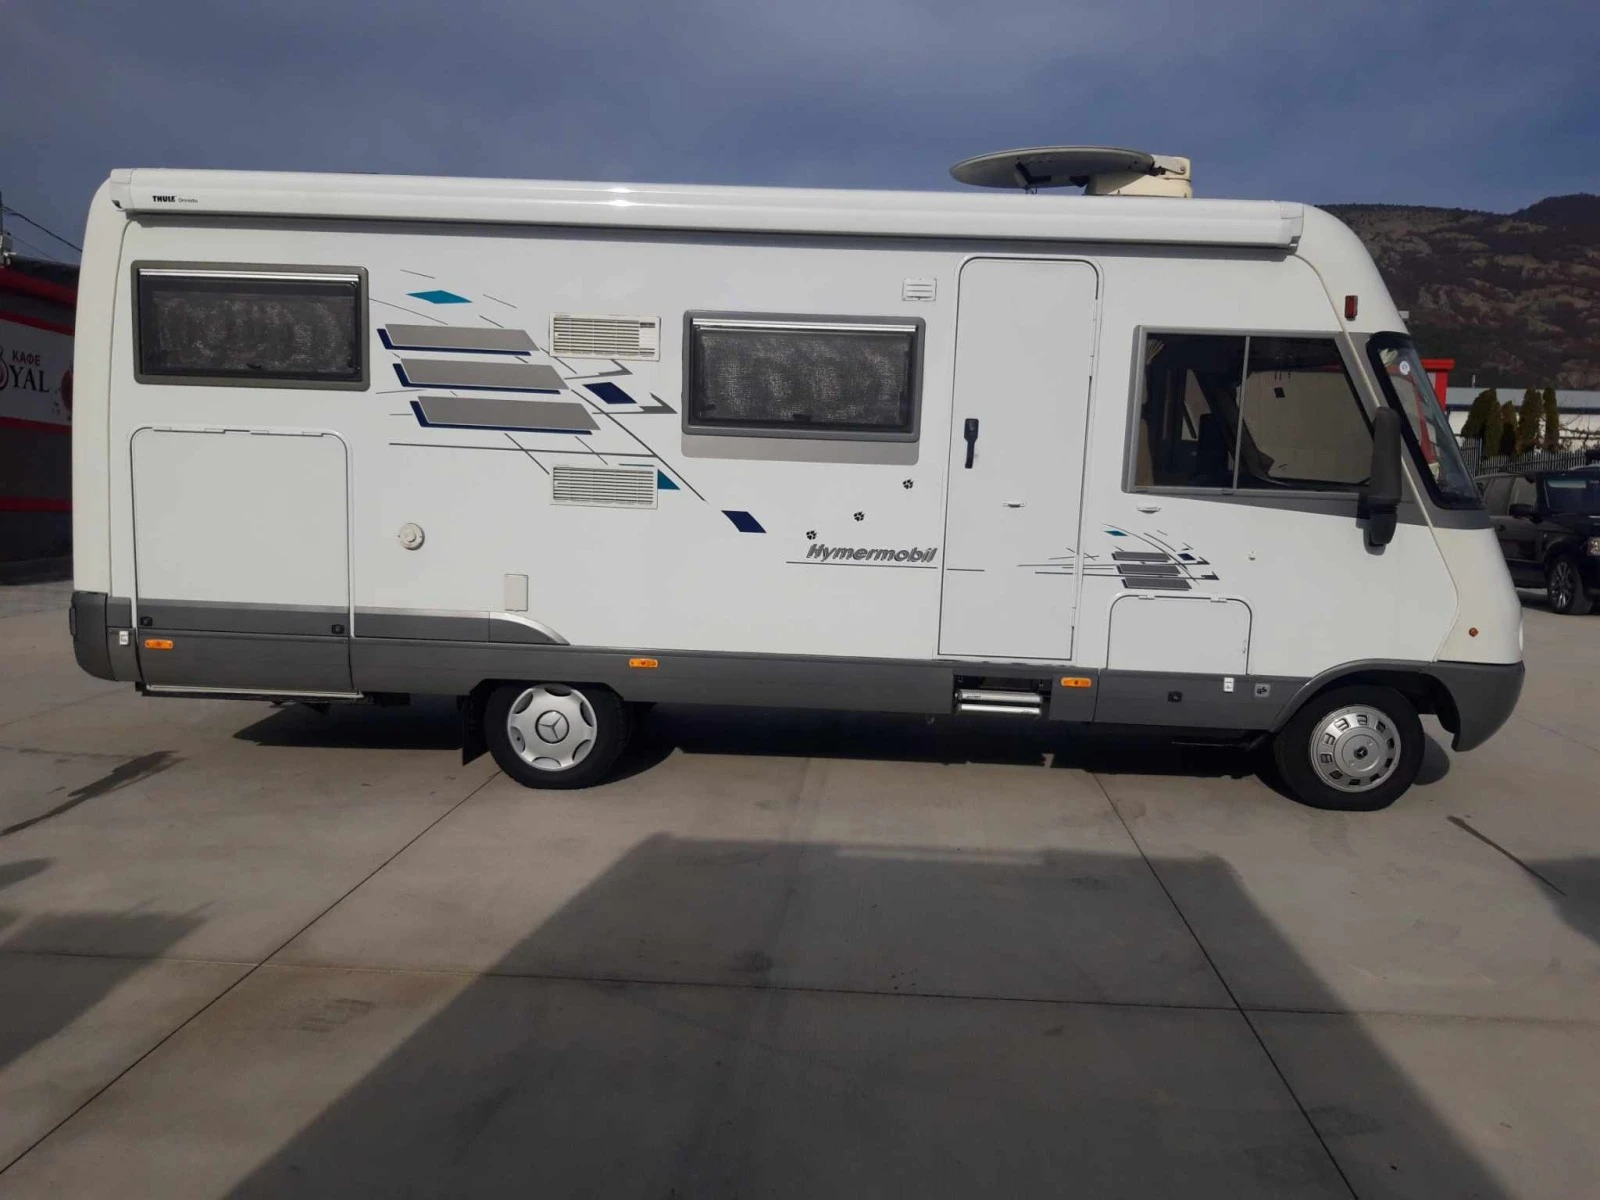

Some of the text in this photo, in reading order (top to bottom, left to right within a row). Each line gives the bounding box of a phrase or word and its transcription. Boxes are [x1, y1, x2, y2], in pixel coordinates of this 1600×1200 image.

[152, 195, 176, 203] THULE
[12, 349, 41, 367] КАФЕ
[805, 543, 938, 563] Hymermobil
